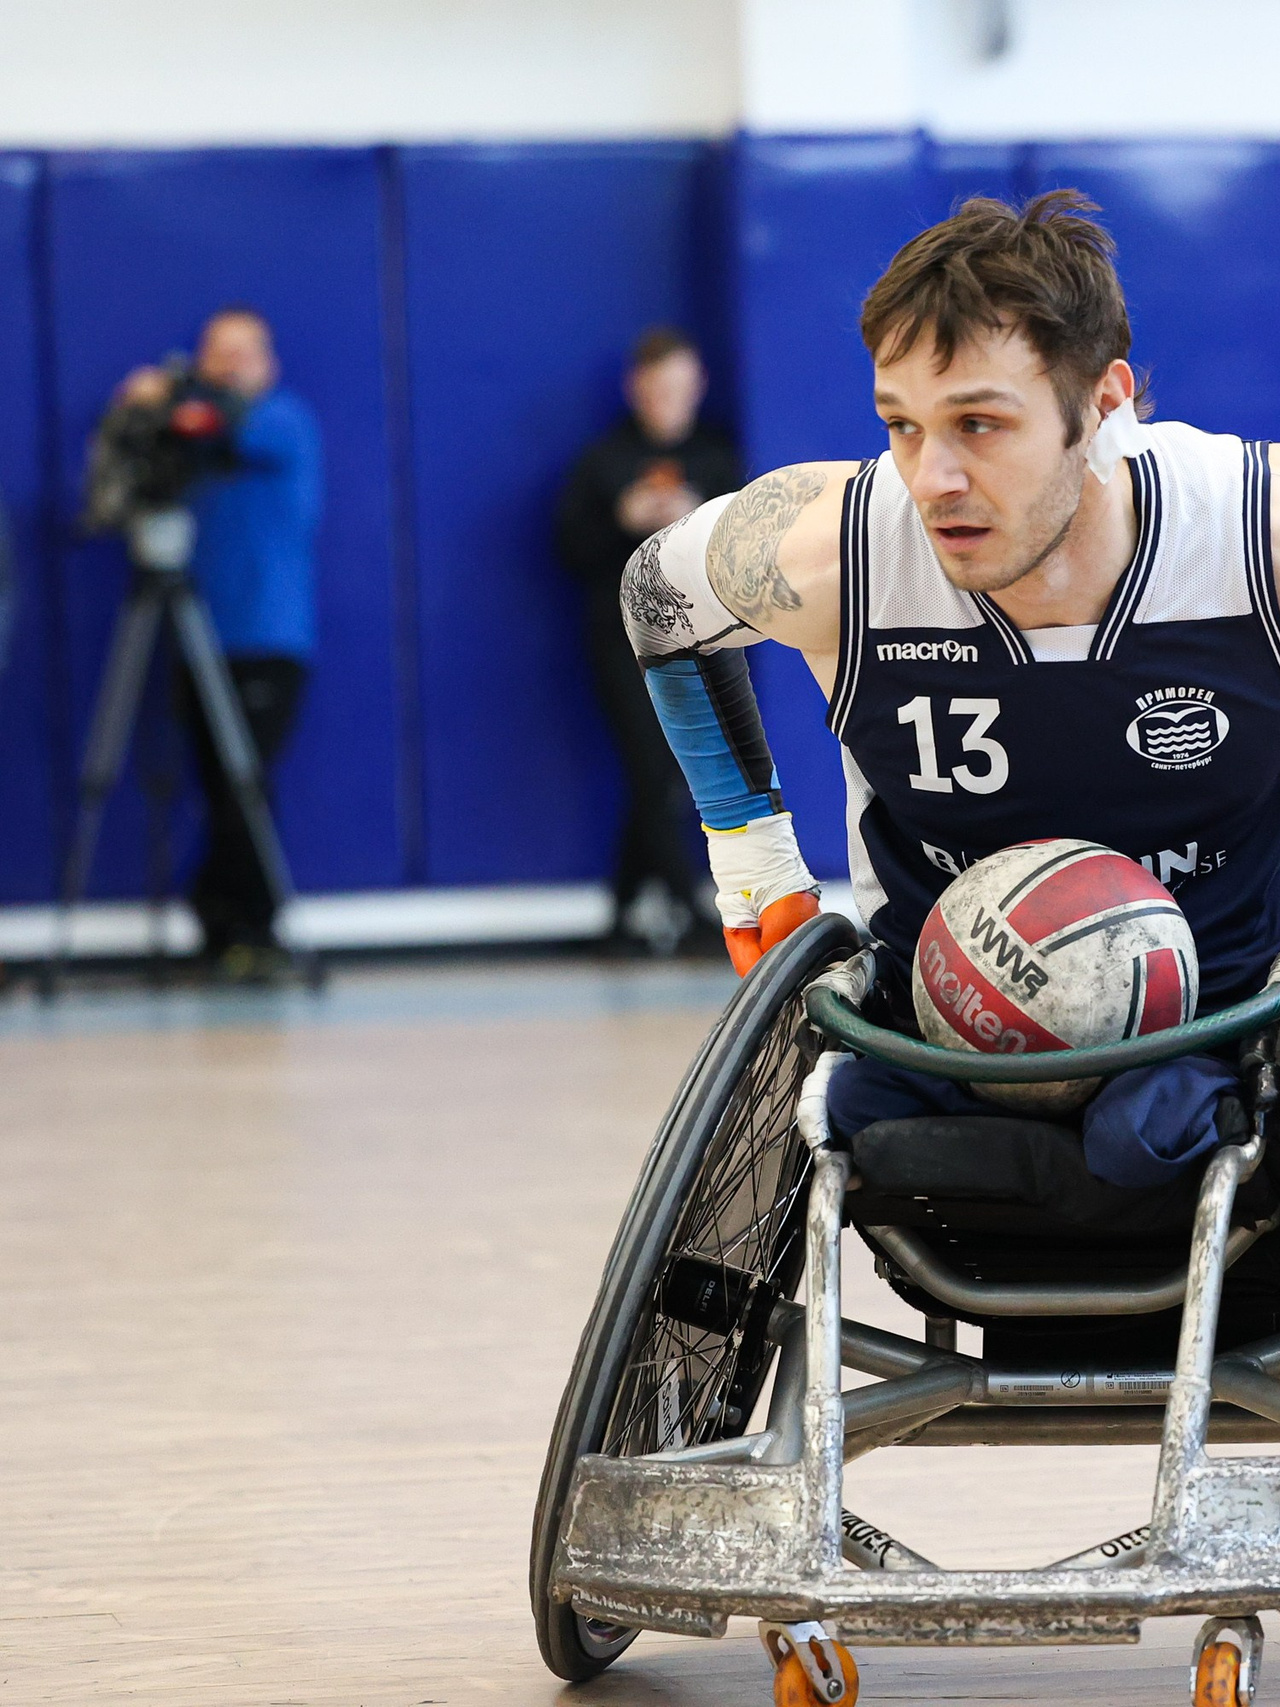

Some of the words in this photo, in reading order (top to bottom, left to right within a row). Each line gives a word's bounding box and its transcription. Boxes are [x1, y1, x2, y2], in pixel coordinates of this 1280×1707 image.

[876, 639, 979, 663] macron
[1135, 686, 1216, 711] ПРИМОРЕЦ
[897, 695, 1010, 795] 13
[1172, 751, 1190, 760] 1974
[1150, 755, 1213, 771] санкт-петербург
[923, 940, 1028, 1054] molten
[700, 1280, 716, 1312] DELFI
